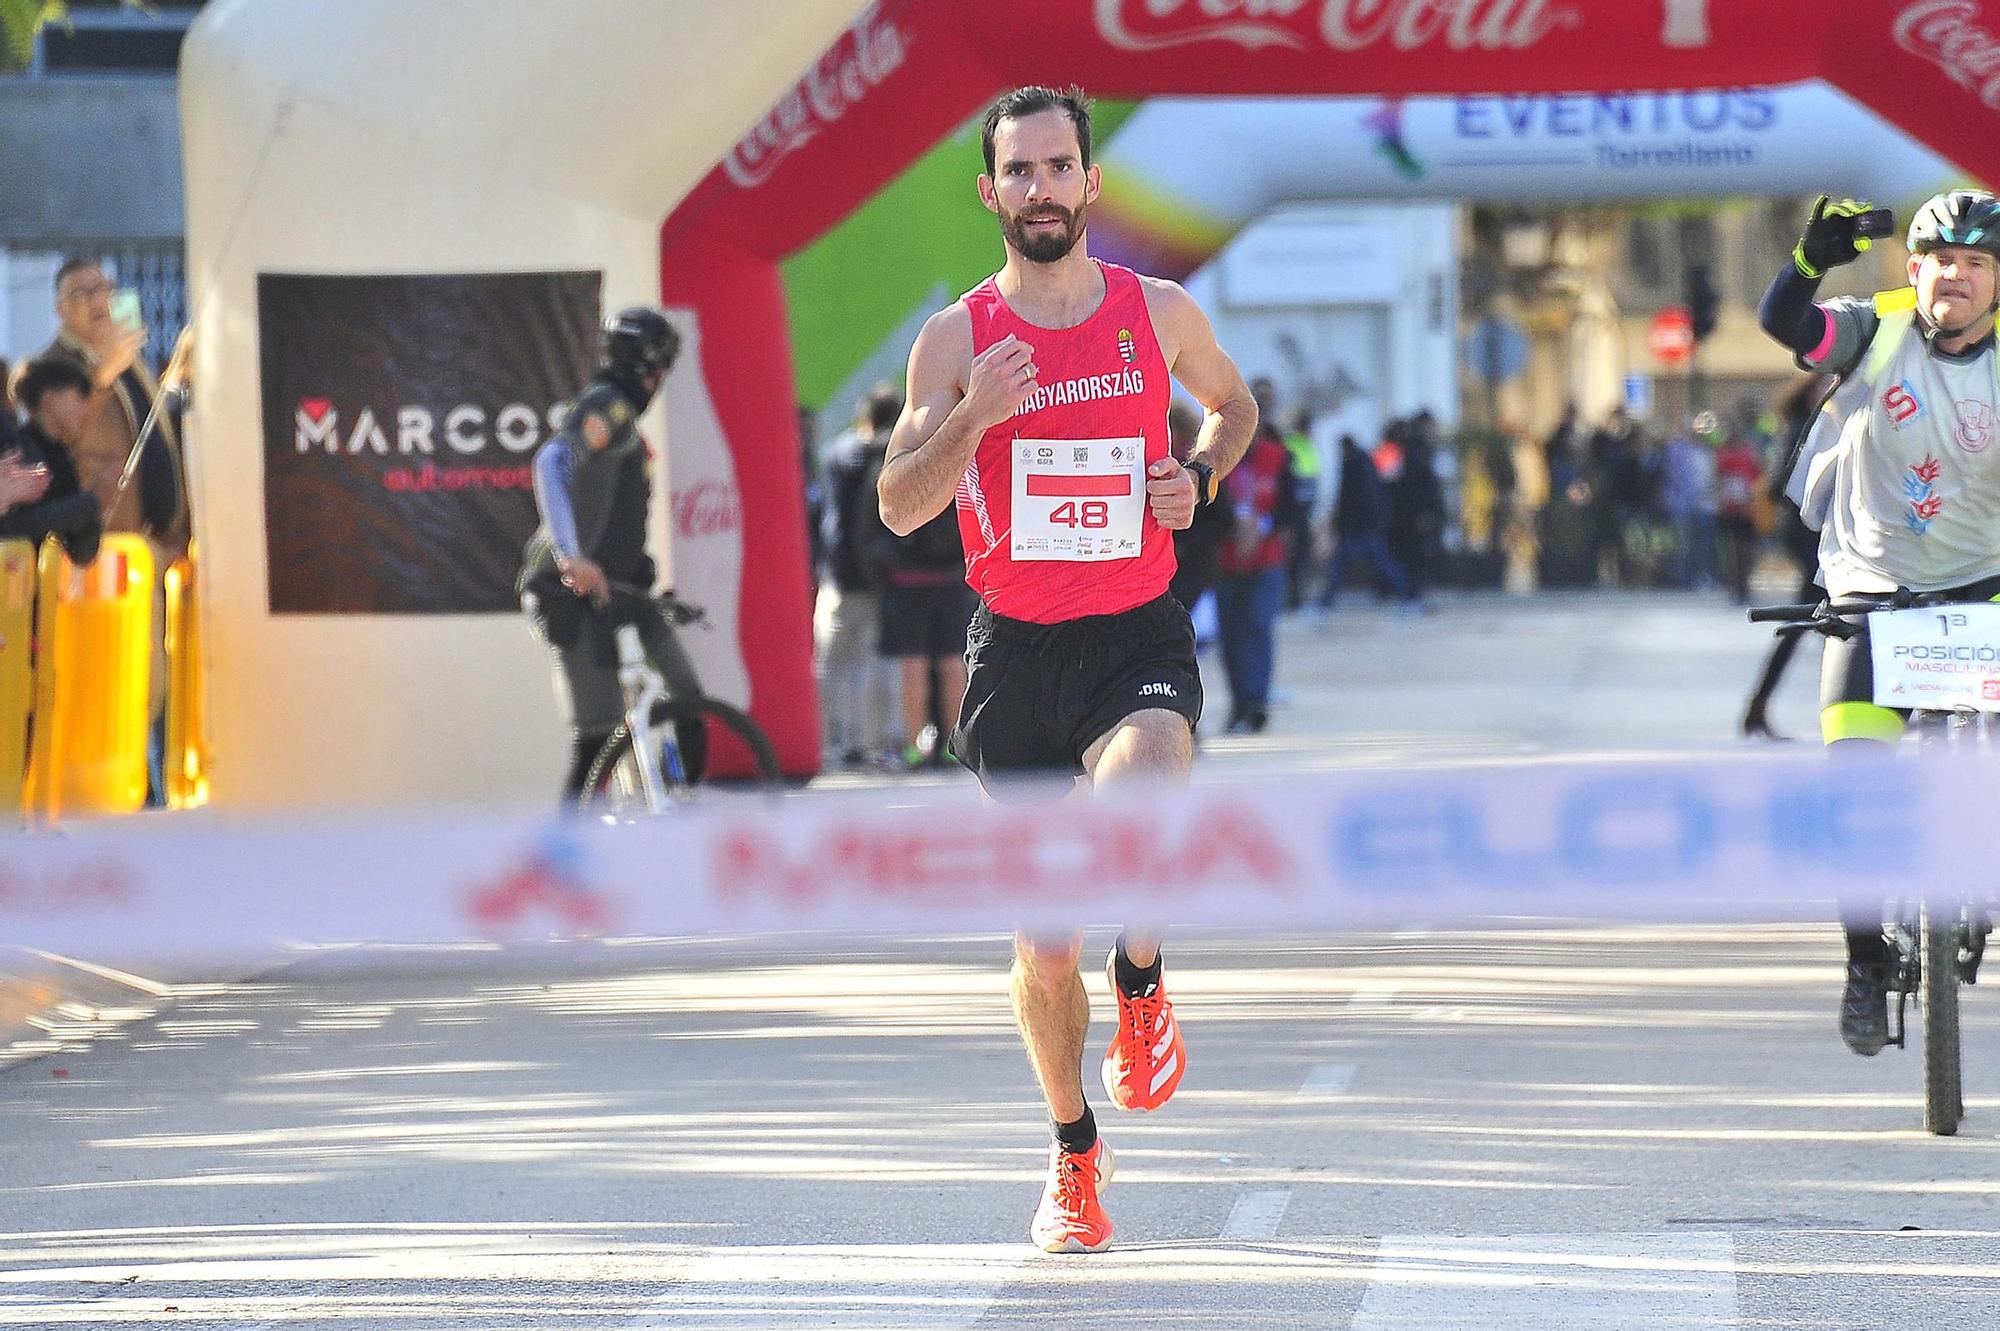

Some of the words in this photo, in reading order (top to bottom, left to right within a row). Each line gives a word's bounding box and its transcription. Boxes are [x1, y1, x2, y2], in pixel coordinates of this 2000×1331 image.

[1456, 88, 1777, 136] EVENTOS
[1049, 501, 1108, 528] 48
[1894, 644, 2000, 662] POSICIÓ
[712, 804, 1293, 905] MEDIA
